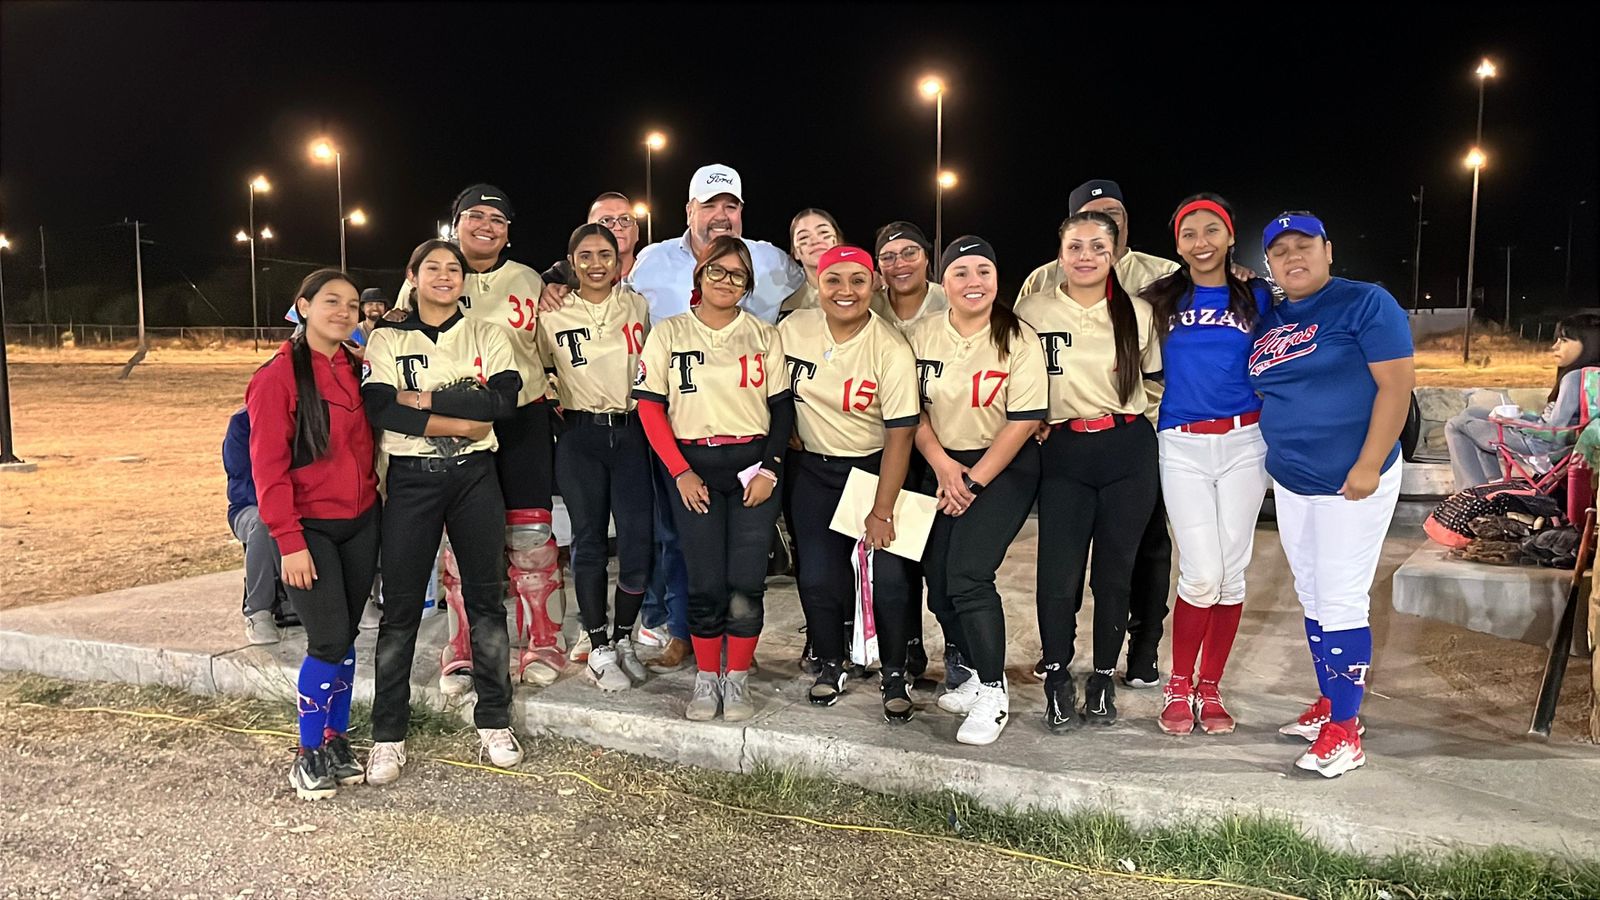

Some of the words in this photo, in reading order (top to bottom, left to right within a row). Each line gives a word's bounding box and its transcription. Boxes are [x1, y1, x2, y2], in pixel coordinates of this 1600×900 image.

[706, 172, 734, 186] Ford
[1279, 217, 1291, 229] T
[508, 294, 535, 332] 32
[555, 327, 590, 368] T
[1036, 332, 1072, 375] T
[396, 354, 429, 391] T
[669, 351, 704, 394] T
[739, 353, 765, 388] 13
[786, 355, 817, 402] T
[916, 359, 943, 404] T
[971, 370, 1009, 408] 17
[842, 377, 877, 412] 15
[1348, 664, 1370, 685] T
